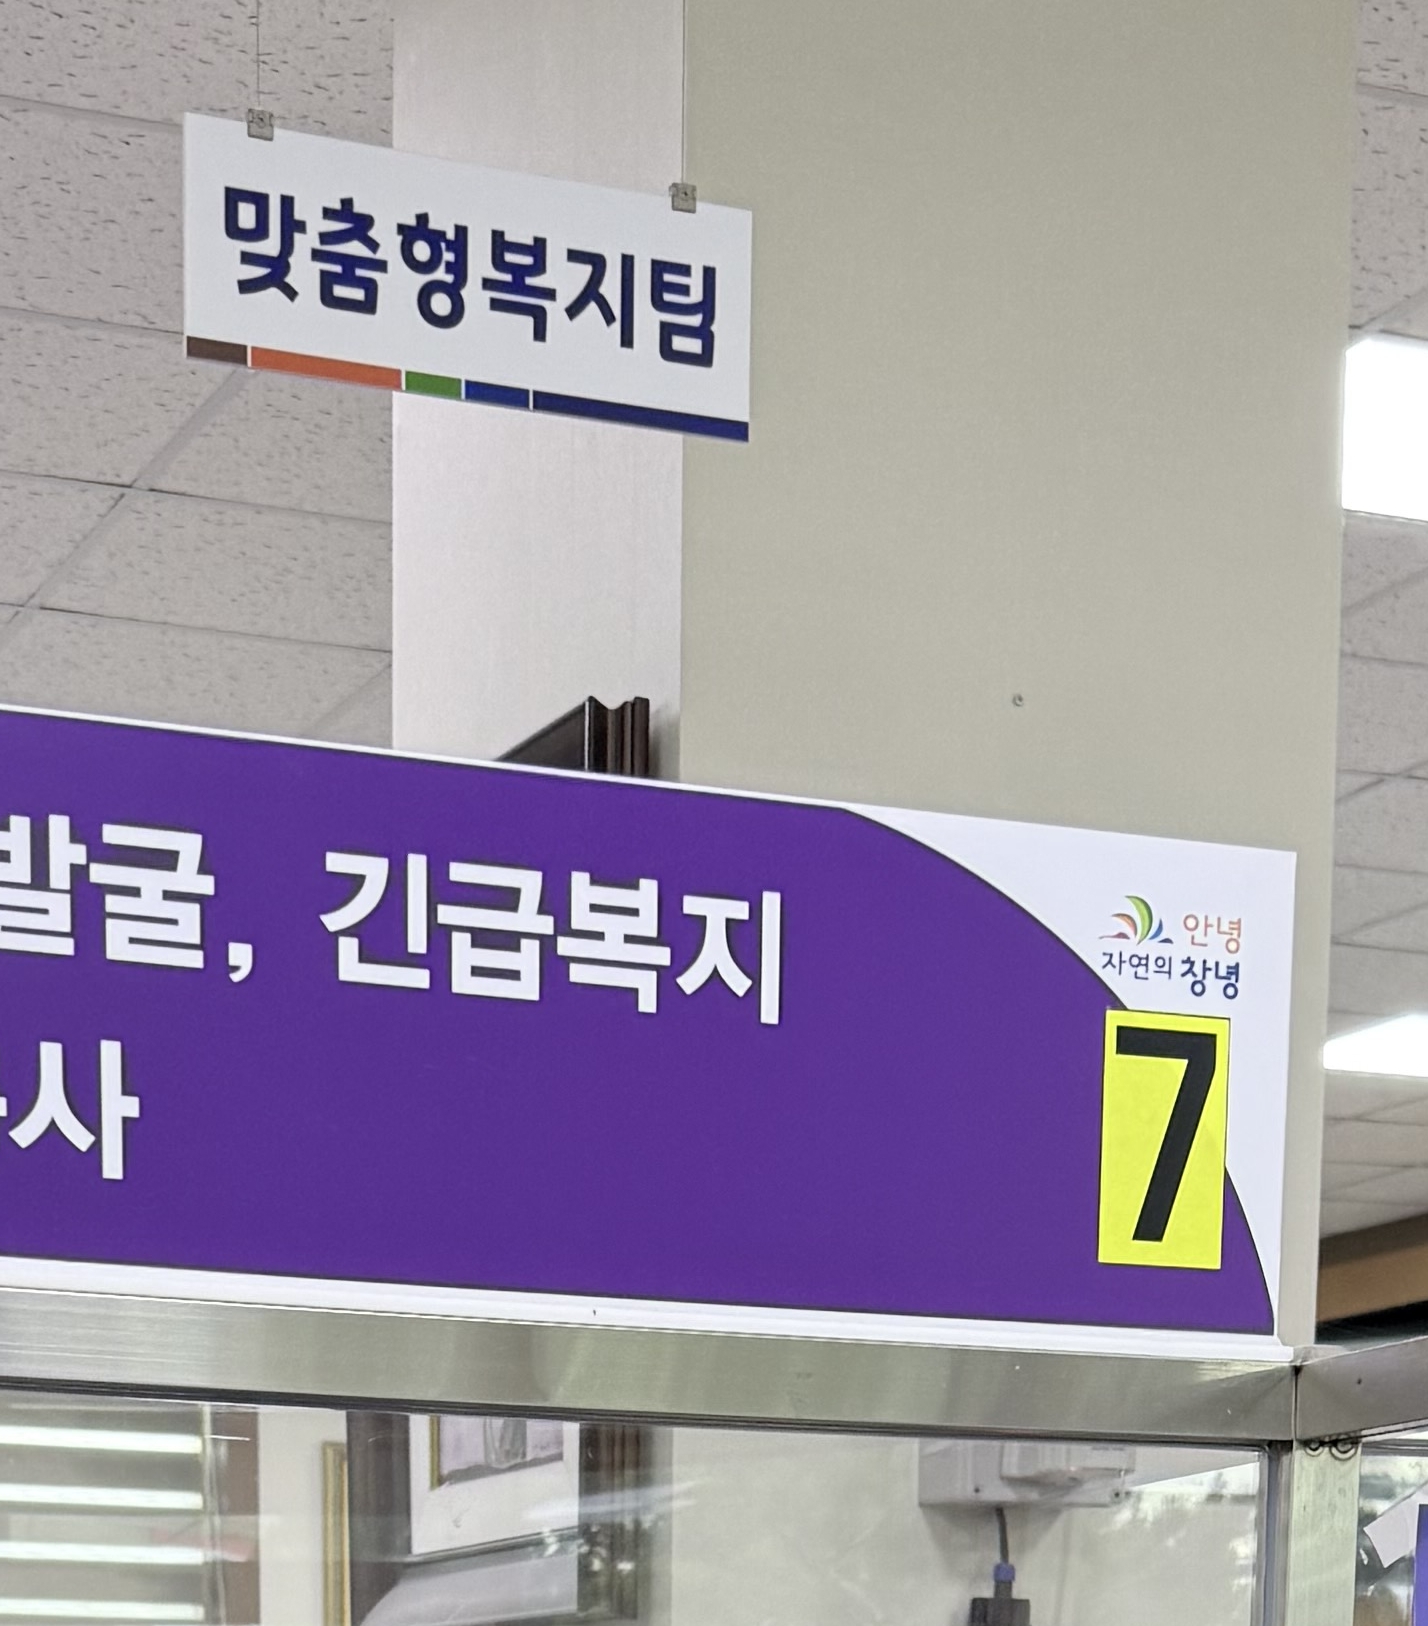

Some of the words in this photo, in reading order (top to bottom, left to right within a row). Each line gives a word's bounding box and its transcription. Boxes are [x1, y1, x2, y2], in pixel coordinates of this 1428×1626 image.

[224, 186, 716, 369] 맞춤형복지팀
[320, 852, 780, 1024] 긴급복지
[1102, 951, 1171, 981] 자연의
[1181, 957, 1239, 999] 창녕
[1184, 914, 1241, 954] 안녕
[1116, 1026, 1217, 1242] 7
